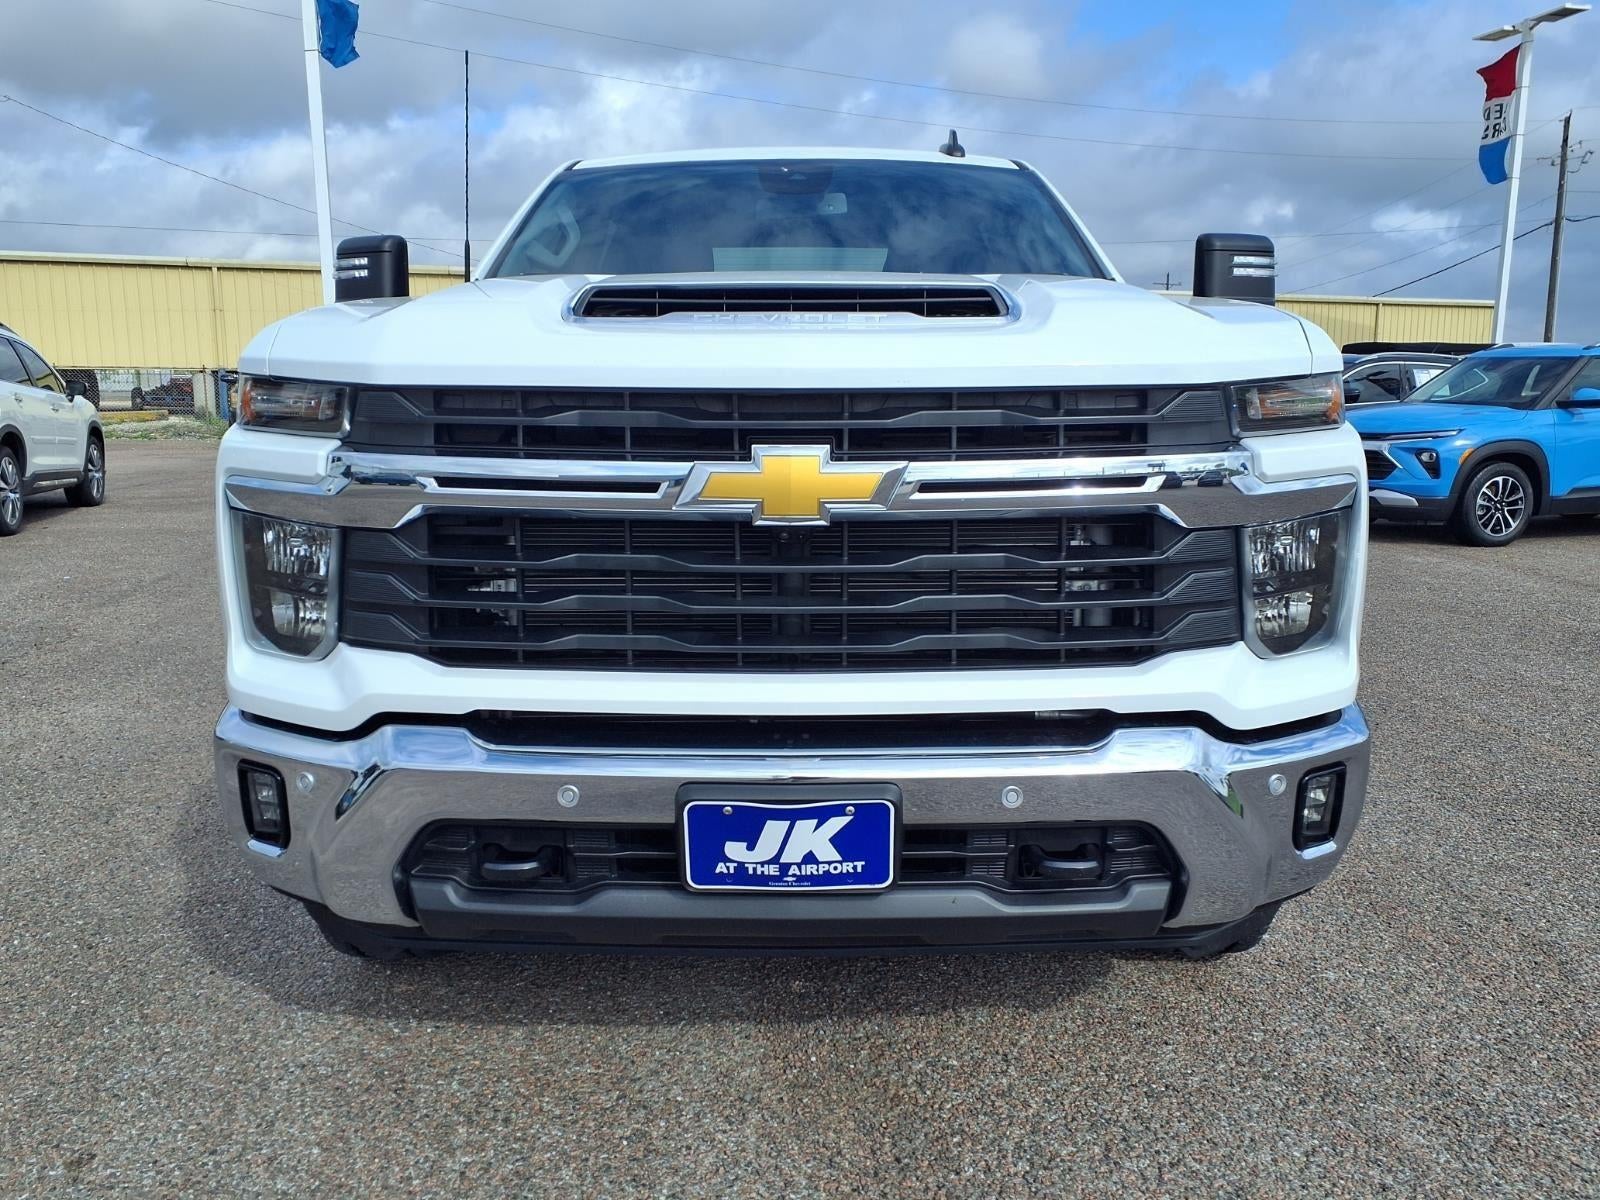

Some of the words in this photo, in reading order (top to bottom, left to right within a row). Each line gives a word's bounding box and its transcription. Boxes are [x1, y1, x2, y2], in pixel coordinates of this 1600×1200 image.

[693, 313, 887, 326] CHEVROLET
[724, 815, 855, 863] JK
[715, 862, 738, 874] AT
[745, 863, 780, 876] THE
[788, 861, 866, 876] AIRPORT
